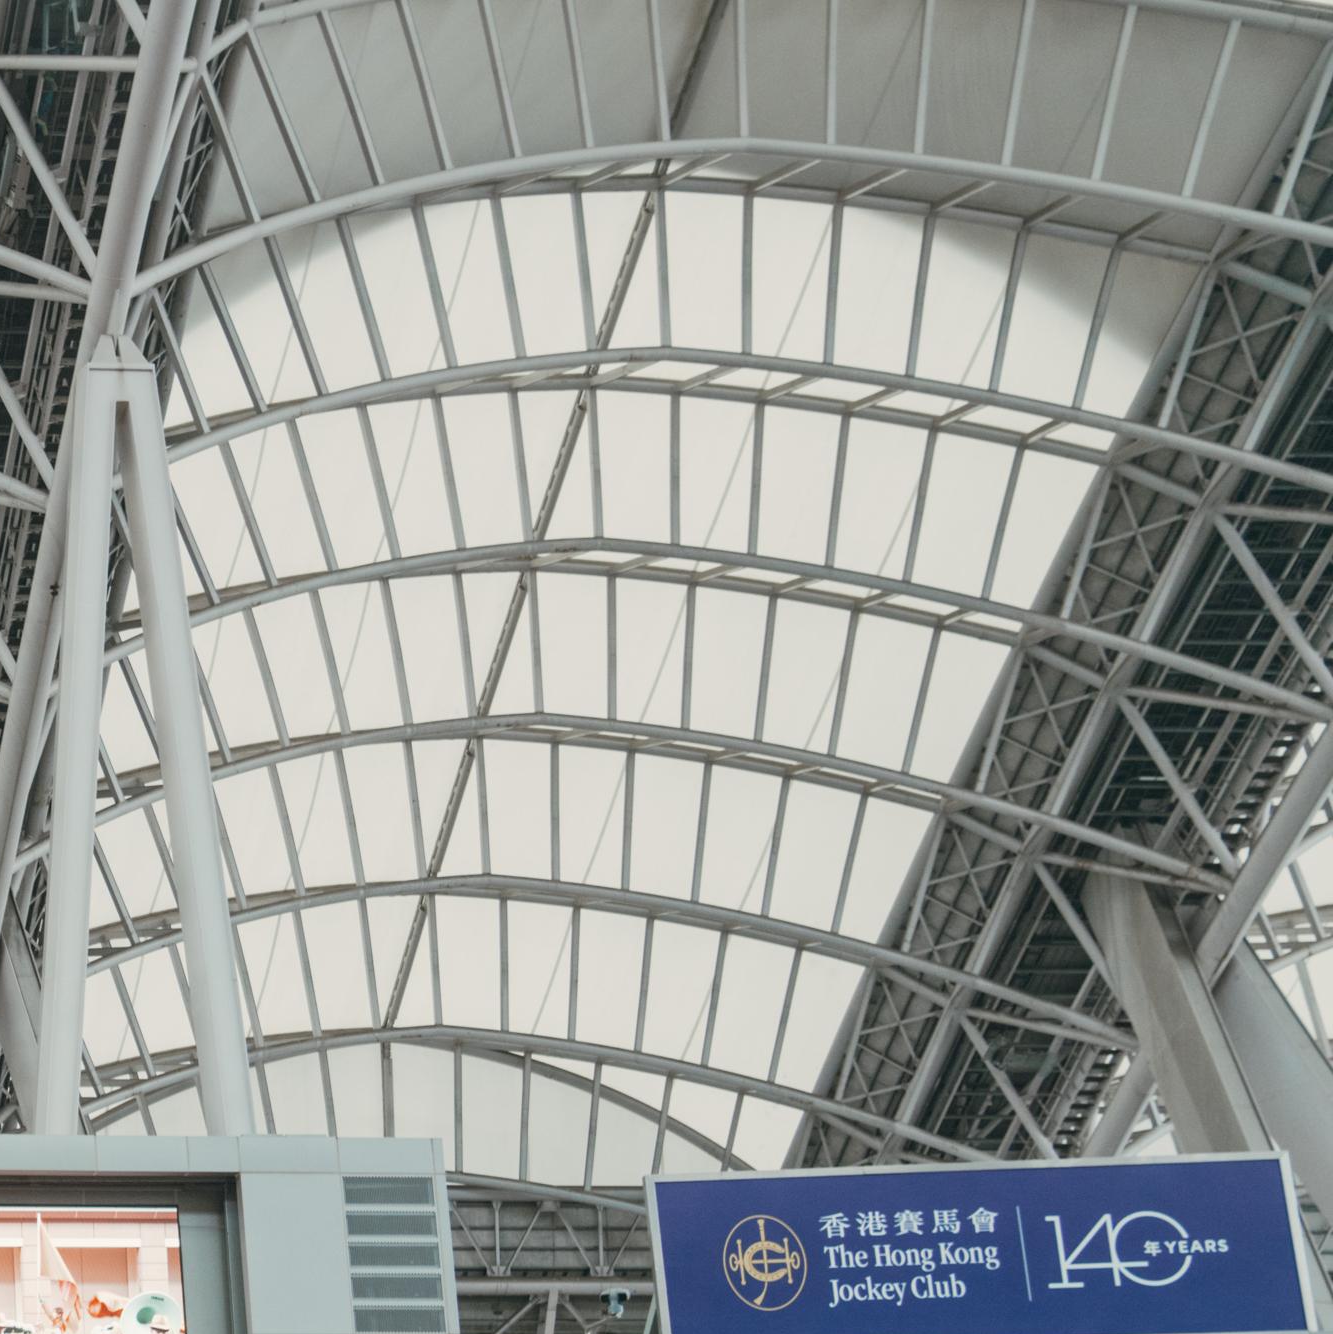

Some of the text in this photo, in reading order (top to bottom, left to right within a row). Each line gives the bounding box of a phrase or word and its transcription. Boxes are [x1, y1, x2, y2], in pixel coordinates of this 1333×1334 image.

[818, 1207, 1000, 1239] 香港賽馬會
[823, 1240, 1000, 1272] The Hong Kong
[1164, 1238, 1229, 1256] YEARS
[829, 1276, 966, 1308] Jockey Club
